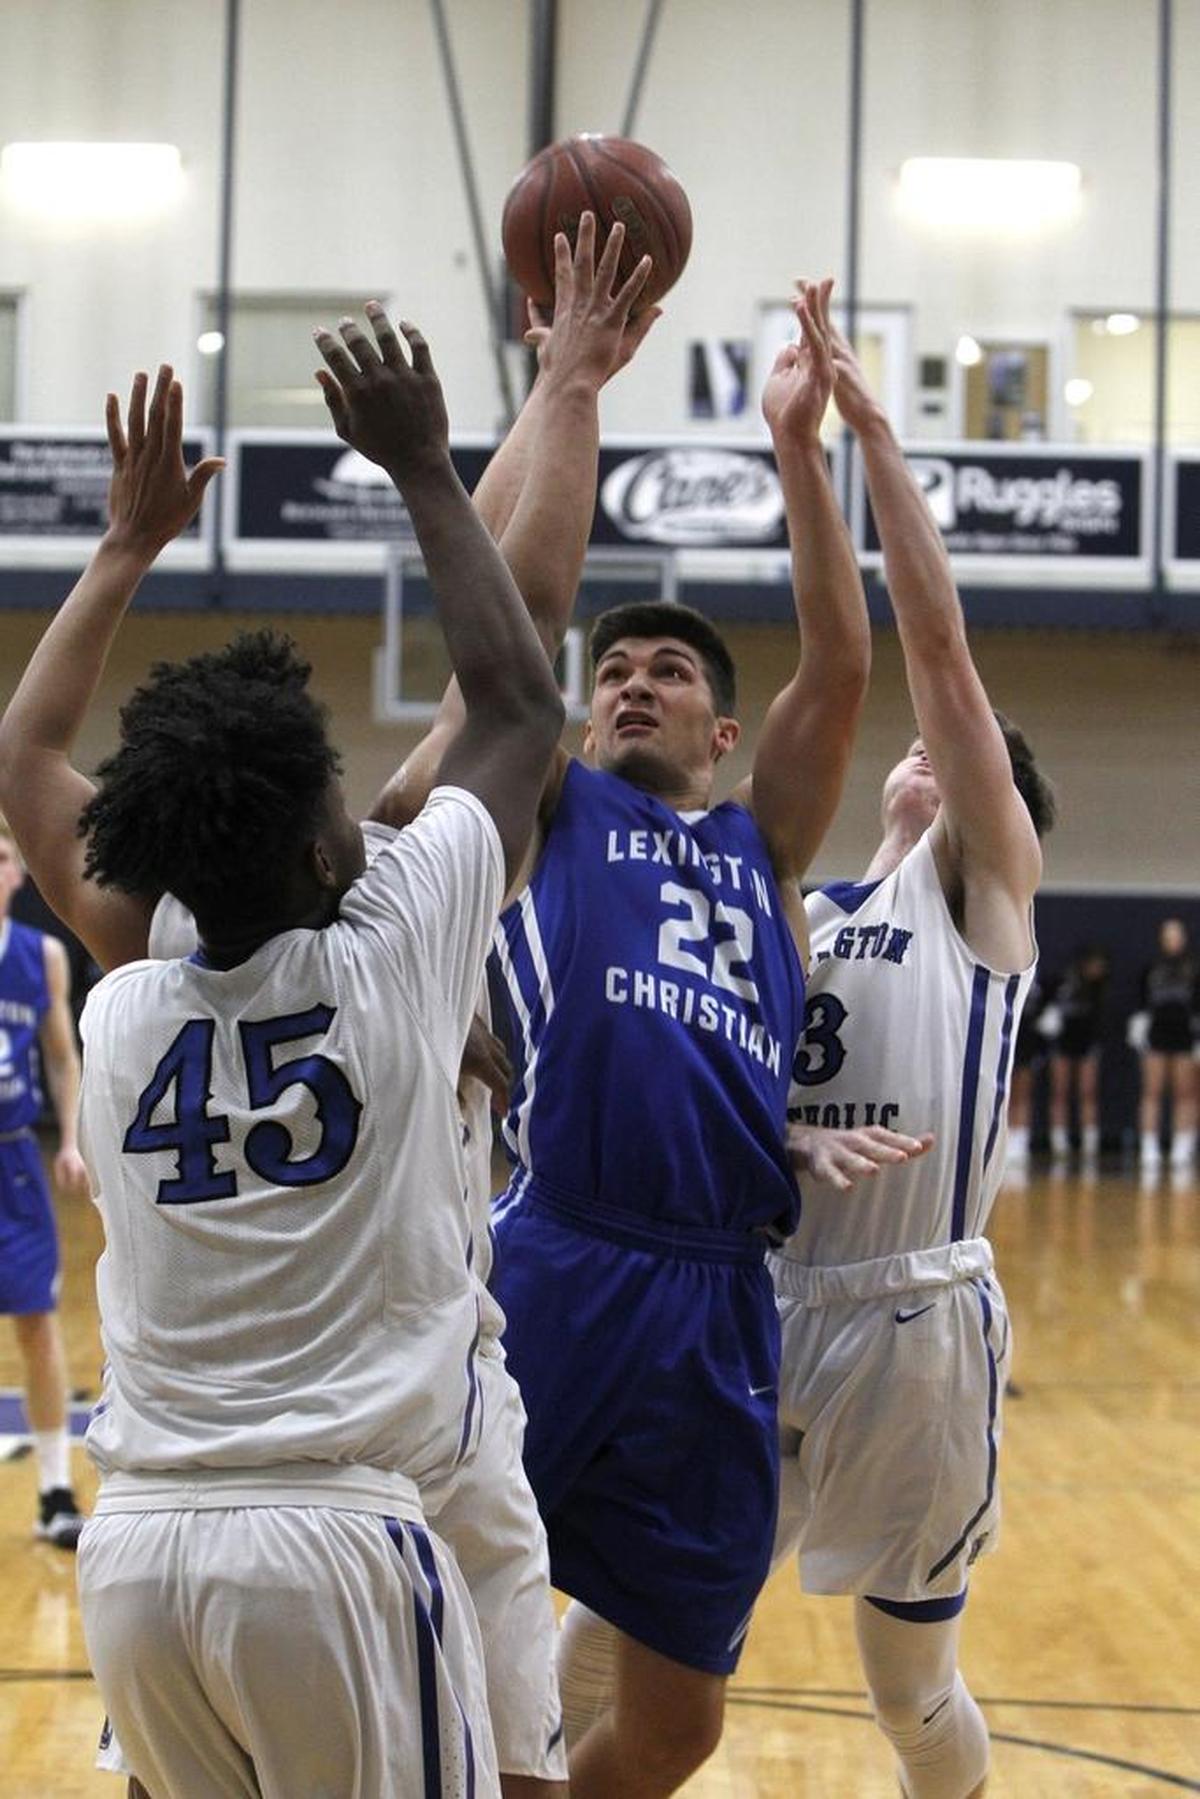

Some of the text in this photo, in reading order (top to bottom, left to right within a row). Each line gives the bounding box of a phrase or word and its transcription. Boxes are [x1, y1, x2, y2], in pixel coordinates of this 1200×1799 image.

[957, 466, 1122, 527] Ruggles
[657, 880, 760, 1004] 22
[605, 966, 783, 1078] CHRISTIAN
[792, 992, 848, 1086] 3
[122, 1002, 364, 1204] 45
